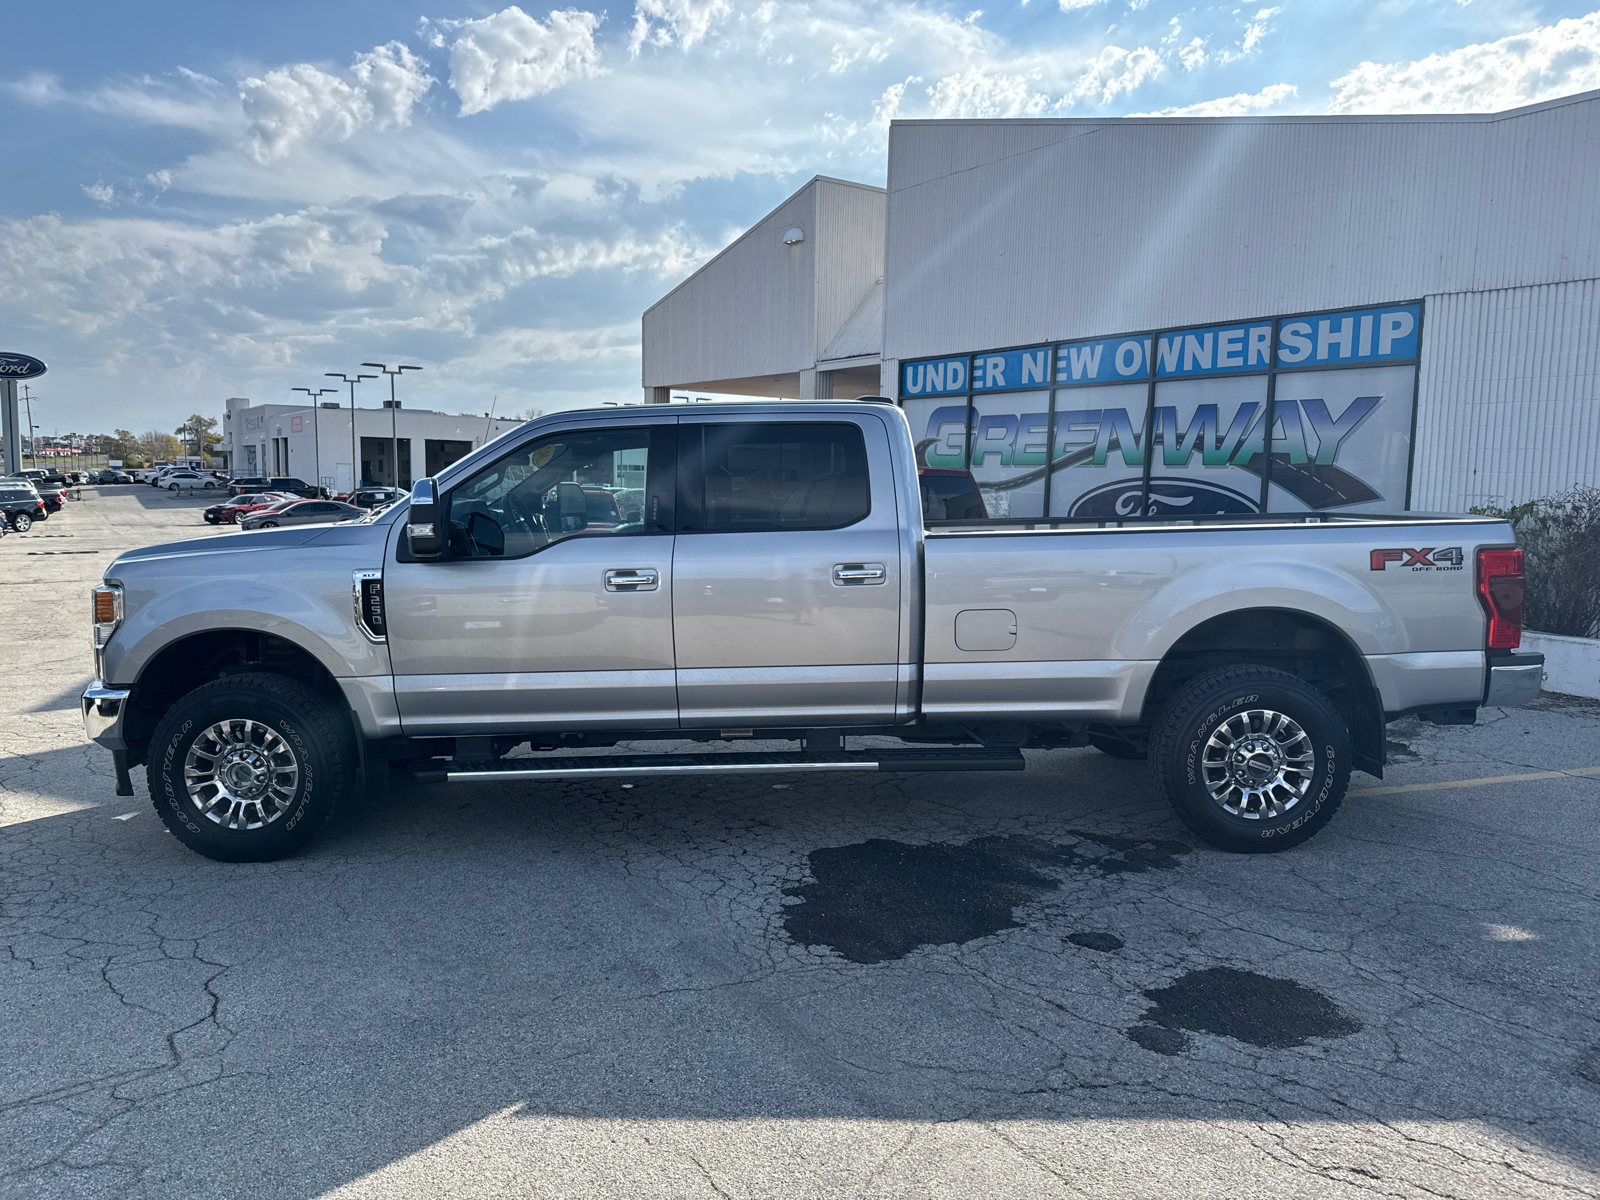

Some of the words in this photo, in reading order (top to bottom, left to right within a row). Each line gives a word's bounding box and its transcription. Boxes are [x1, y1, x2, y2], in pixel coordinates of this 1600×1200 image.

[906, 356, 1007, 394] UNDER
[1021, 345, 1103, 384] NEW
[1114, 312, 1414, 376] OWNERSHIP
[925, 396, 1384, 468] GREENWAY
[1370, 547, 1464, 571] FX4
[163, 719, 201, 834] GOODYEAR
[279, 719, 314, 831] WRANGLER
[1186, 694, 1259, 785] WRANGLER
[1260, 744, 1335, 838] GOODYEAR
